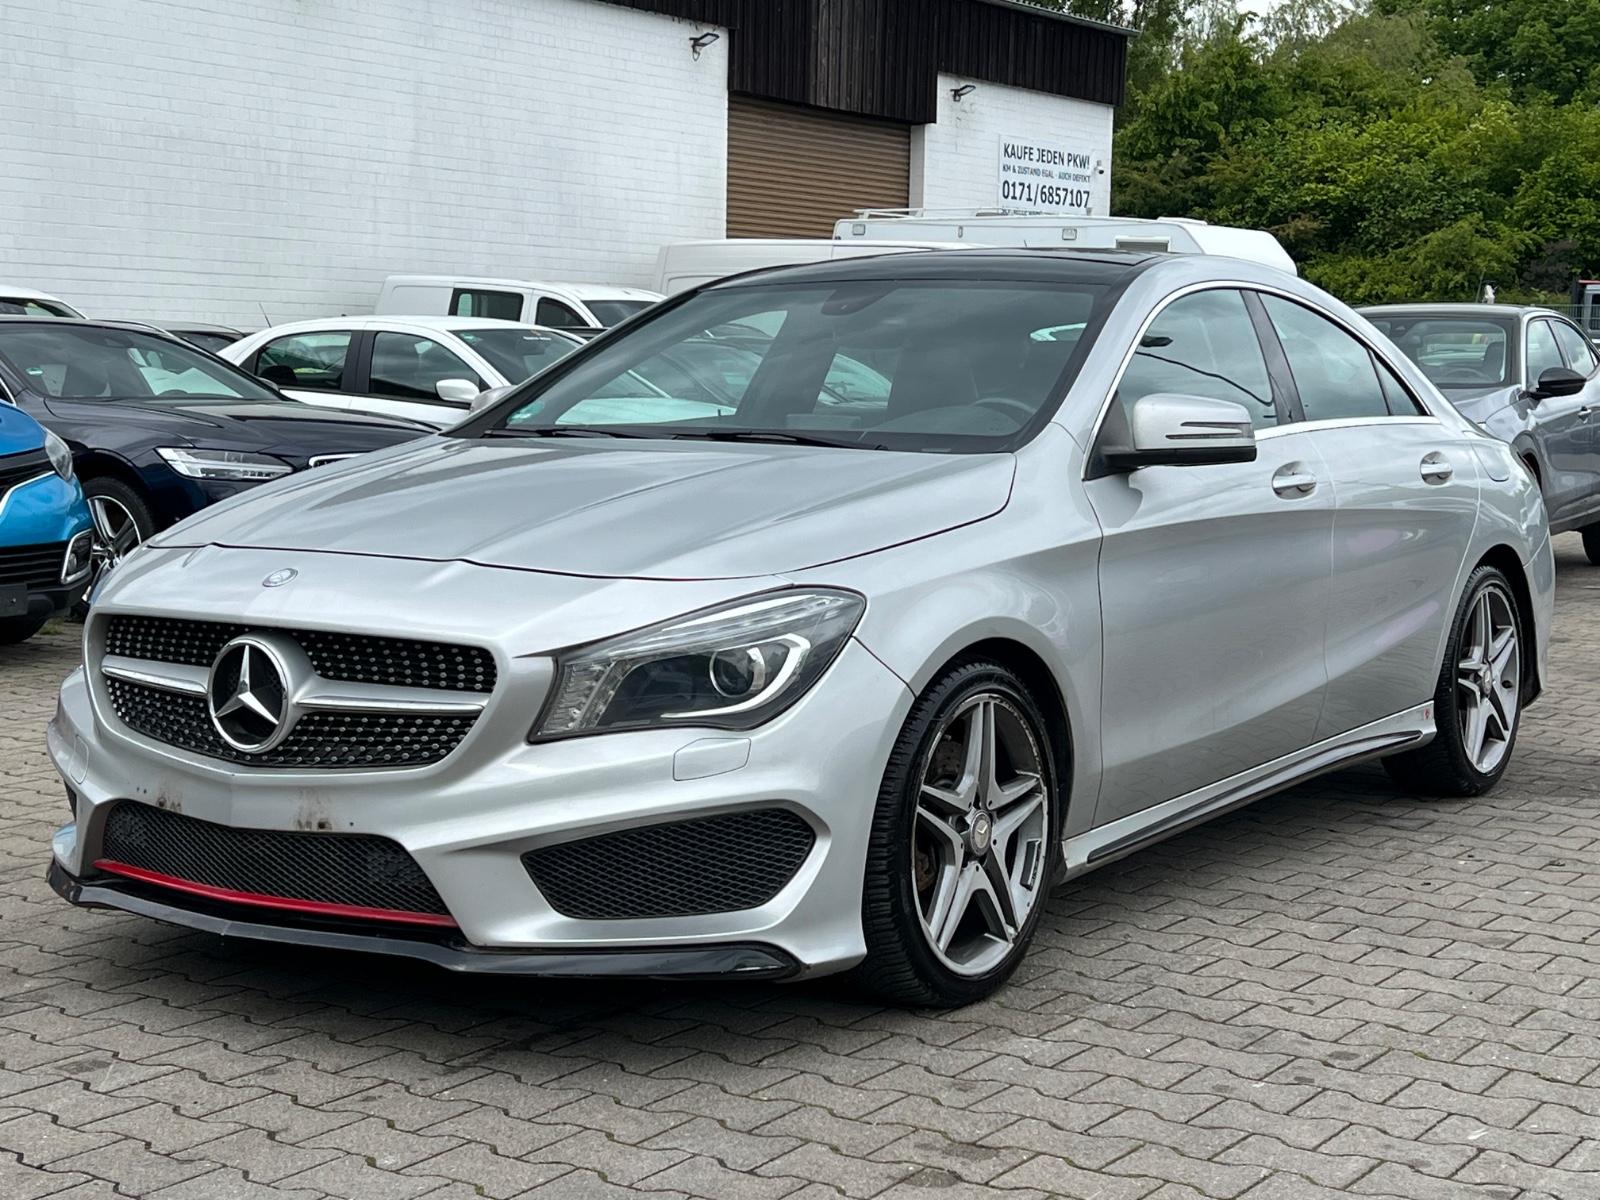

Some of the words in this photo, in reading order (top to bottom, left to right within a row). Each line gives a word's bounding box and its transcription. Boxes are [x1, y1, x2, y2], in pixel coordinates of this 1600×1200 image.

[1003, 143, 1034, 161] KAUFE
[1036, 148, 1064, 166] JEDEN
[1067, 153, 1090, 169] PKW!
[1002, 164, 1011, 172] KM
[1012, 165, 1016, 173] &
[1017, 166, 1041, 176] ZUSTAND
[1042, 168, 1054, 179] EGAL
[1058, 171, 1071, 181] AUCH
[1072, 173, 1091, 183] DEFEKT
[1002, 180, 1090, 209] 0171/6857107
